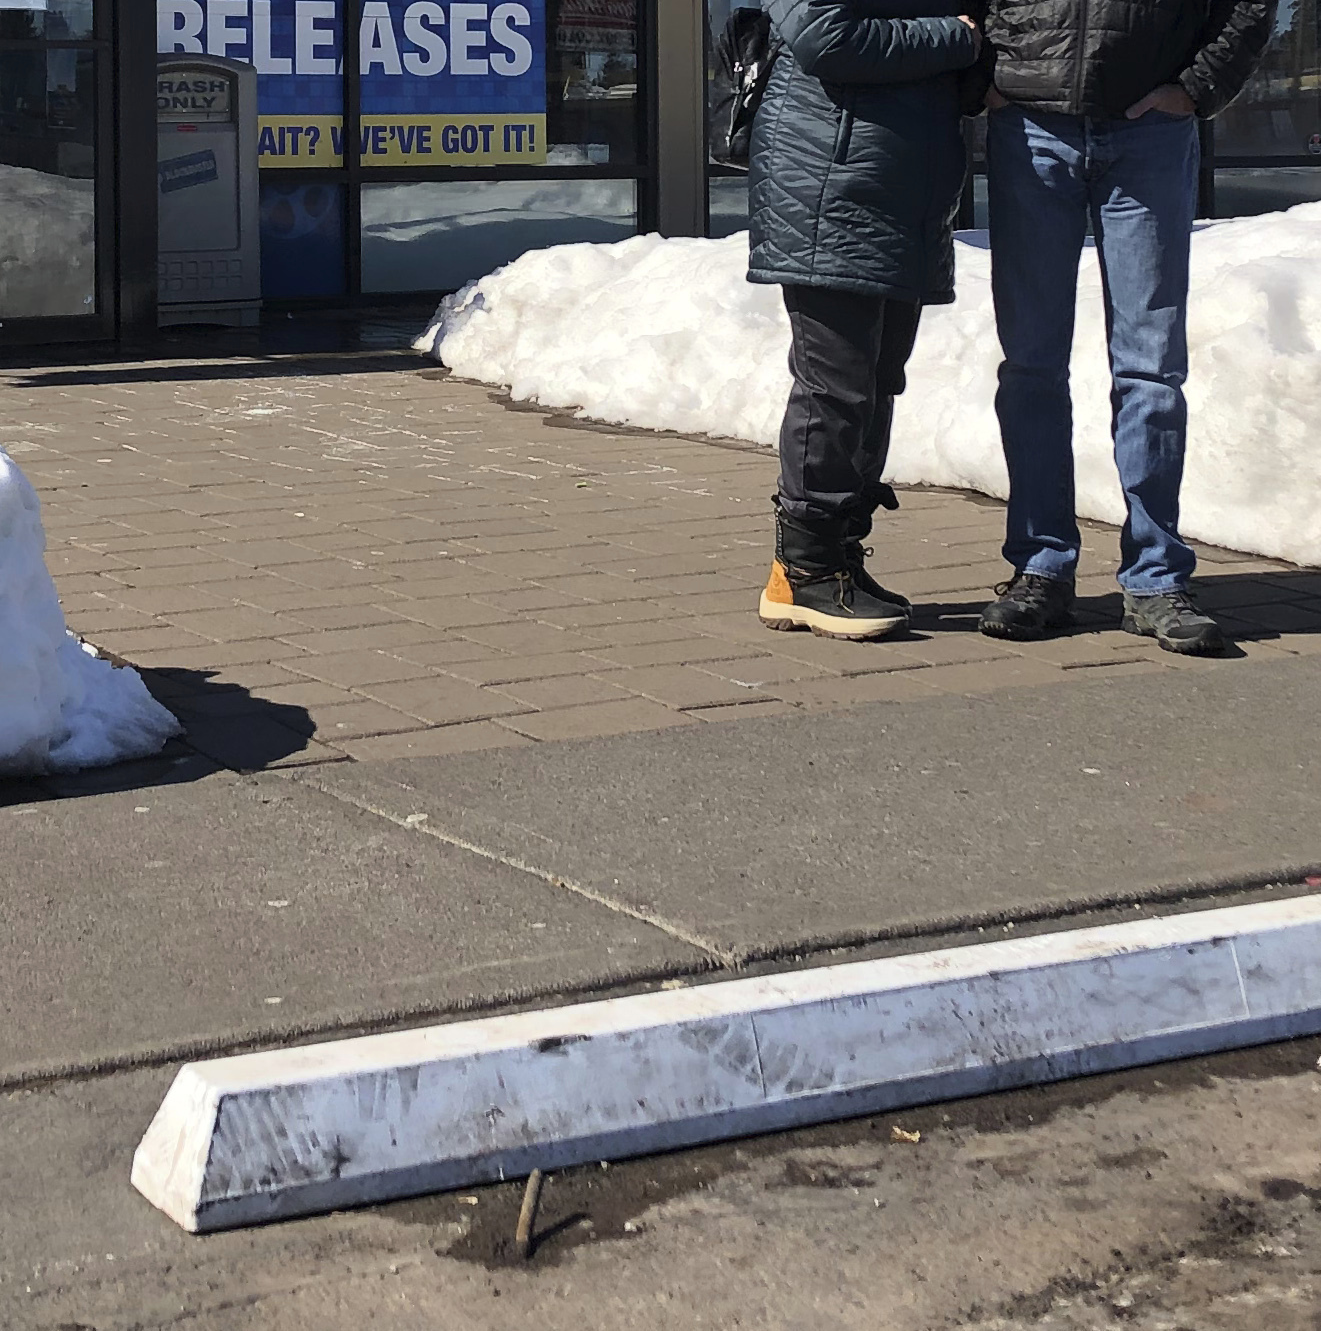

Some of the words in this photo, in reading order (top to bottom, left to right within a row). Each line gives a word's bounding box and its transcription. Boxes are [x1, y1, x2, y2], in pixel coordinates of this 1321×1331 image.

[158, 80, 225, 94] RASH
[157, 96, 216, 110] ONLY
[258, 126, 321, 156] AIT?
[441, 124, 495, 154] GOT
[503, 123, 536, 153] IT!
